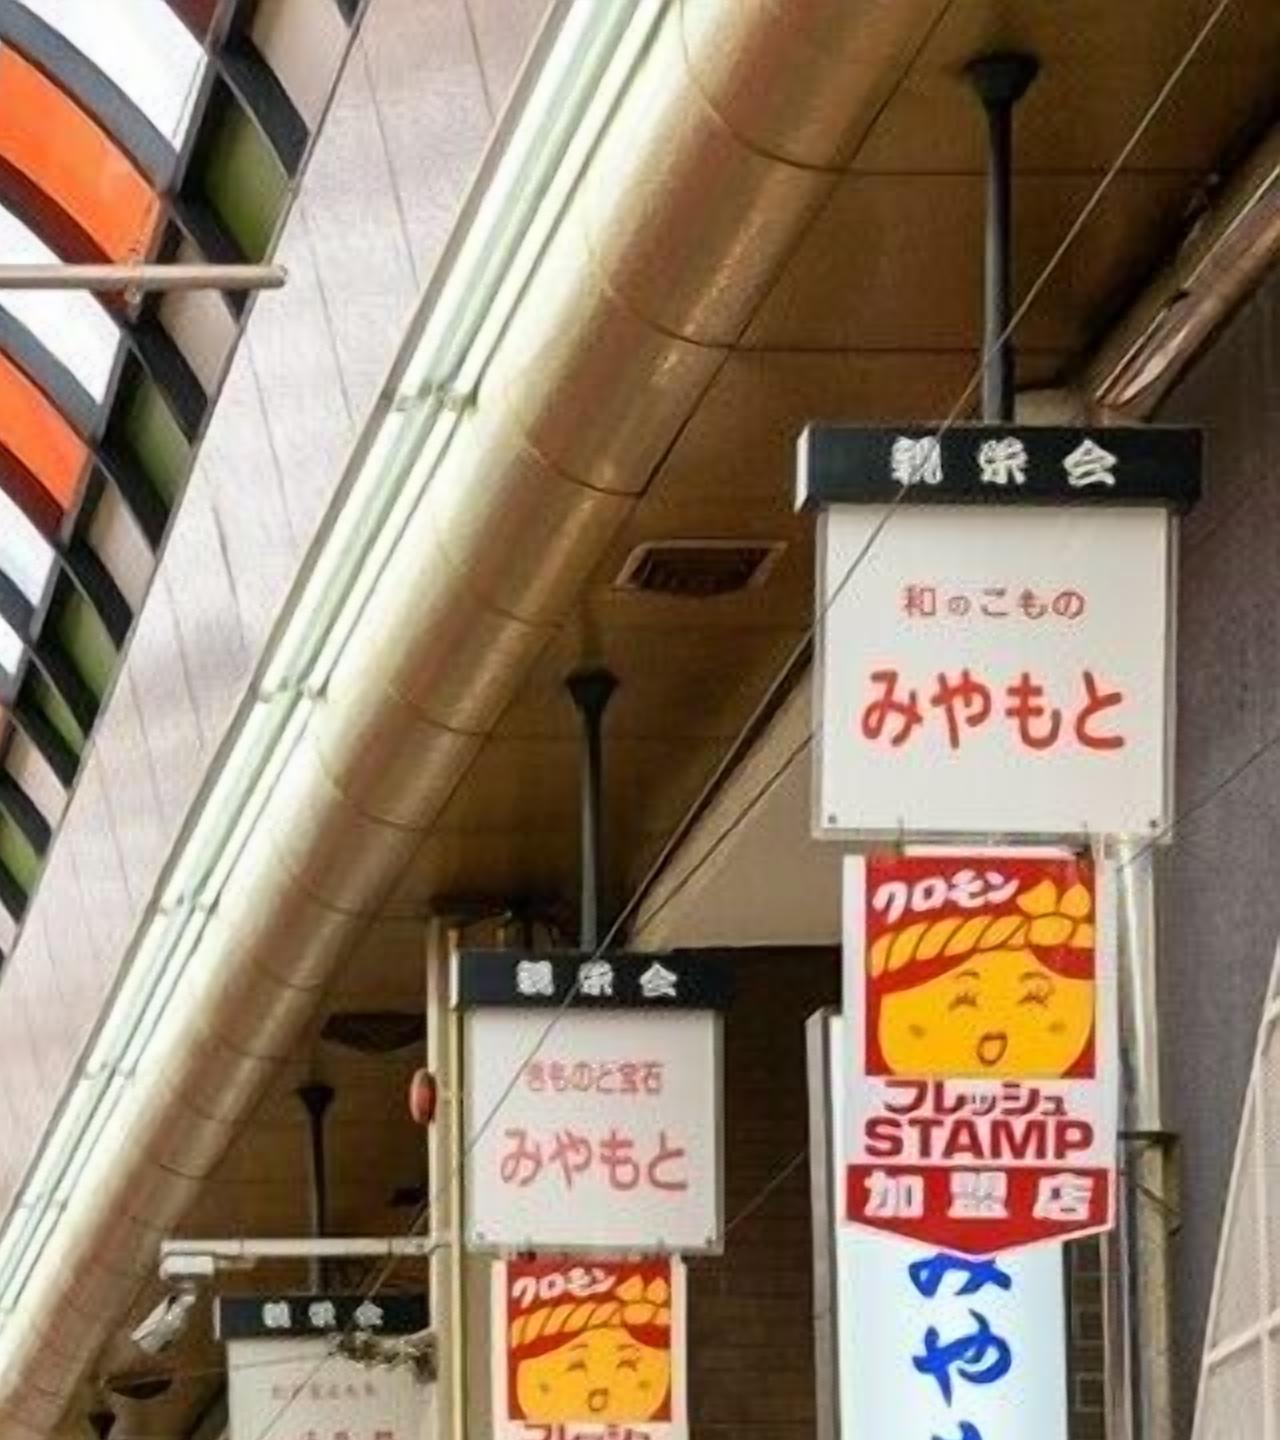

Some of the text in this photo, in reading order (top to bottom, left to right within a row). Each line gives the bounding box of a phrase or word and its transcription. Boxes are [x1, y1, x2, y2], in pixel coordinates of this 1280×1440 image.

[861, 669, 1125, 751] みやもと
[872, 868, 1020, 924] クロモン
[882, 1080, 1068, 1117] フレッシュ
[501, 1129, 688, 1193] みやもと
[864, 1117, 1095, 1160] STAMP
[864, 1168, 1094, 1221] 加盟店
